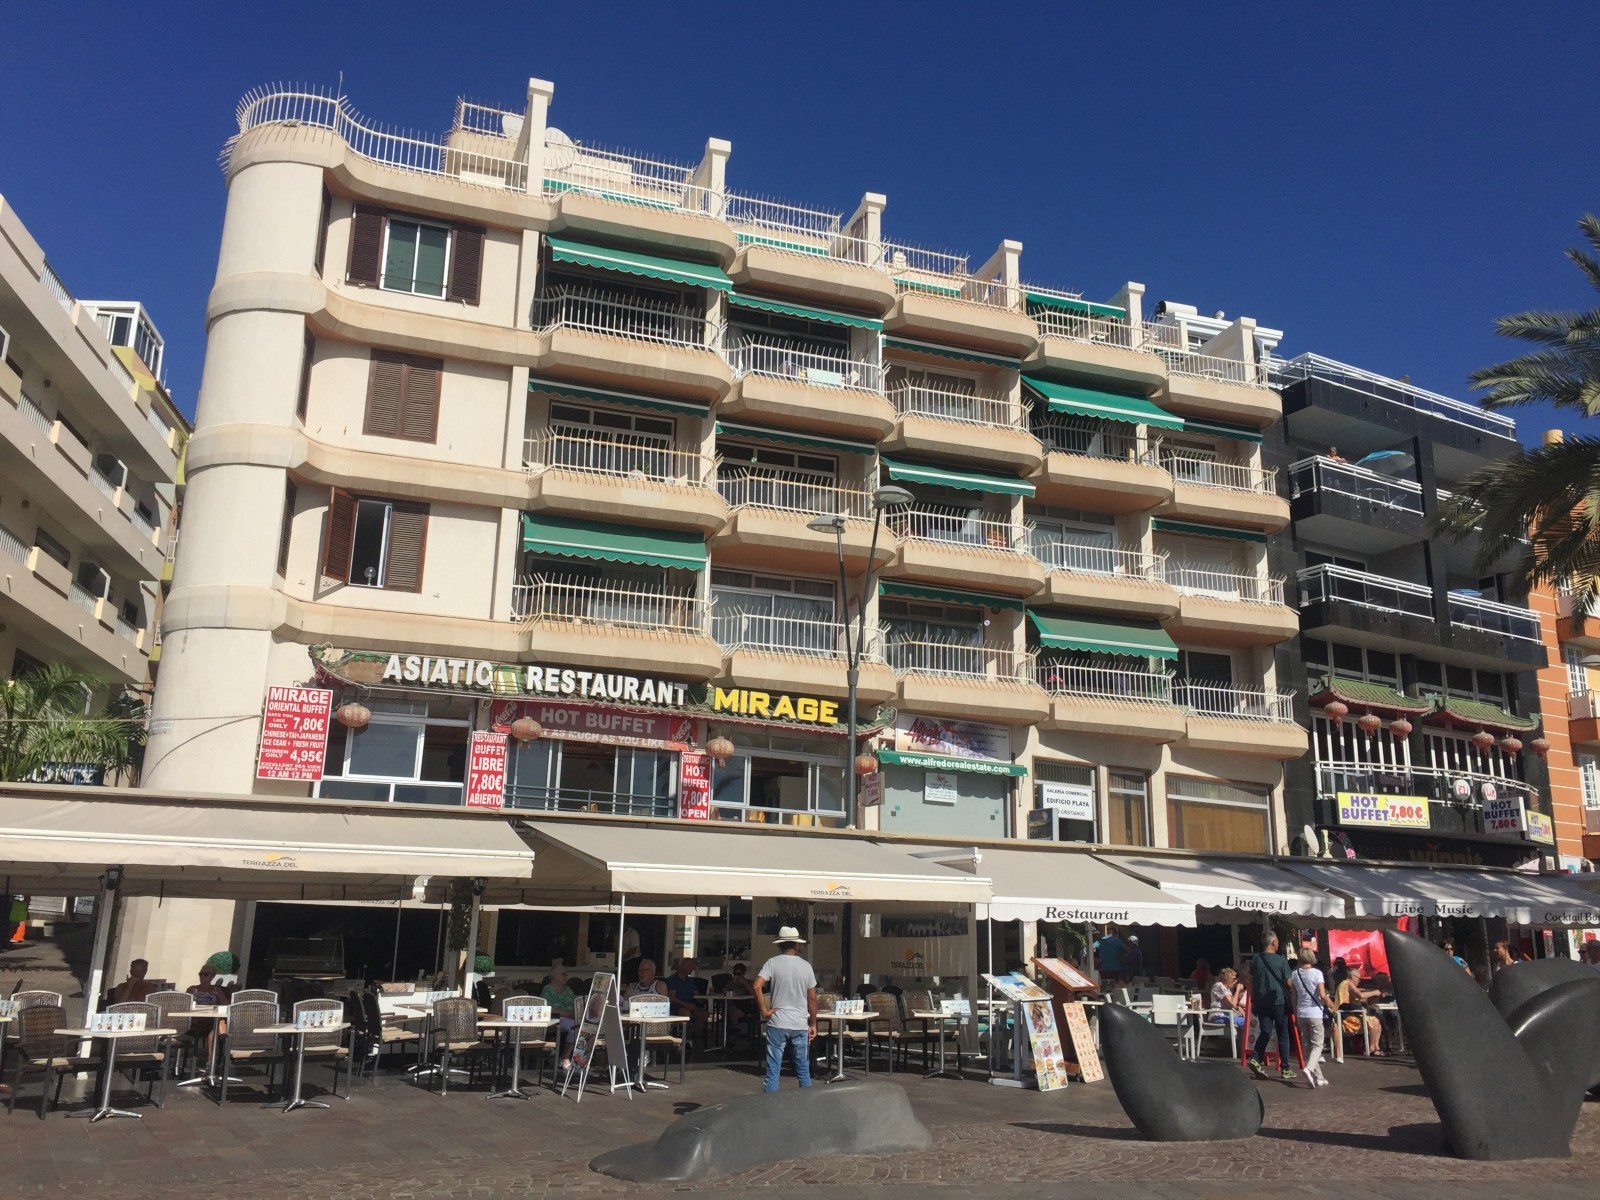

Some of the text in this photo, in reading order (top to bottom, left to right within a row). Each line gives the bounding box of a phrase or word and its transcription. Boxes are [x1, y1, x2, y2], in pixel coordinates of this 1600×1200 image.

[383, 655, 839, 723] ASIATIC RESTAURANT MIRAGE
[270, 688, 329, 704] MIRAGE
[269, 702, 327, 714] ORIENTAL BUFFET
[293, 717, 324, 732] 7,80€
[540, 707, 655, 733] HOT BUFFET
[474, 734, 507, 744] RESTAURANT
[602, 734, 616, 743] AS
[619, 736, 639, 745] YOU
[641, 738, 665, 748] LIKE
[290, 750, 323, 763] 4,95€
[475, 745, 506, 756] BUFFET
[472, 757, 503, 771] LIBRE
[900, 756, 1010, 773] www.alfredorealestate.com
[686, 765, 705, 777] HOT
[471, 773, 502, 793] 7,80€
[683, 778, 708, 788] BUFFET
[469, 793, 502, 805] ABIERTO
[682, 790, 708, 808] 7,80€
[1350, 796, 1378, 808] HOT
[1491, 801, 1511, 810] HOT
[681, 808, 706, 818] OPEN
[1342, 808, 1389, 821] BUFFET
[1484, 809, 1520, 819] BUFFET
[1226, 896, 1288, 910] Linares II
[1395, 903, 1474, 914] Live Music
[1045, 907, 1129, 920] Restaurant
[1545, 913, 1582, 921] Cocktail
